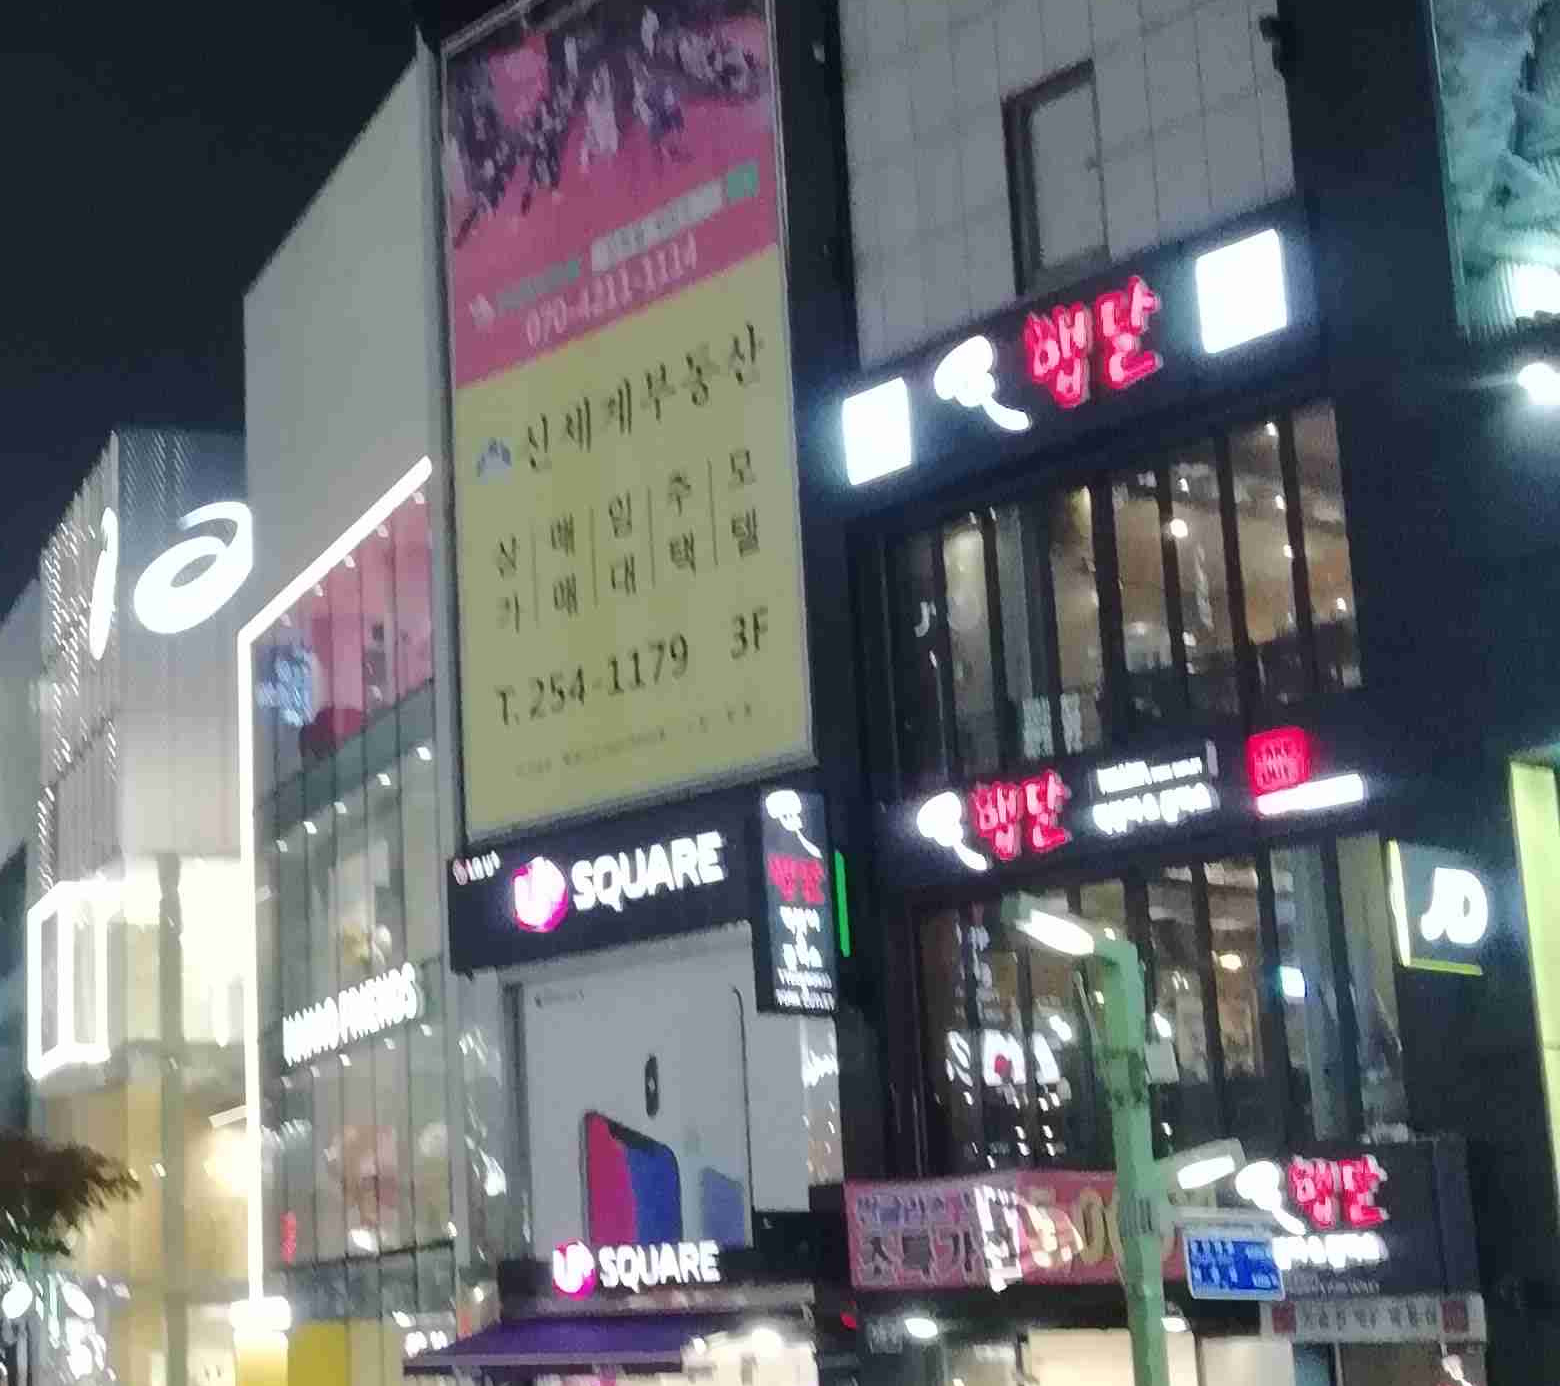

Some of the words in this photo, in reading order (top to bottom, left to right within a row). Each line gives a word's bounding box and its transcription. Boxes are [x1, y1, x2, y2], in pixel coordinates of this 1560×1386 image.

[522, 319, 768, 473] 신세계부동산
[730, 606, 768, 660] 3F
[571, 829, 725, 912] SQUARE
[598, 1239, 721, 1293] SQUARE
